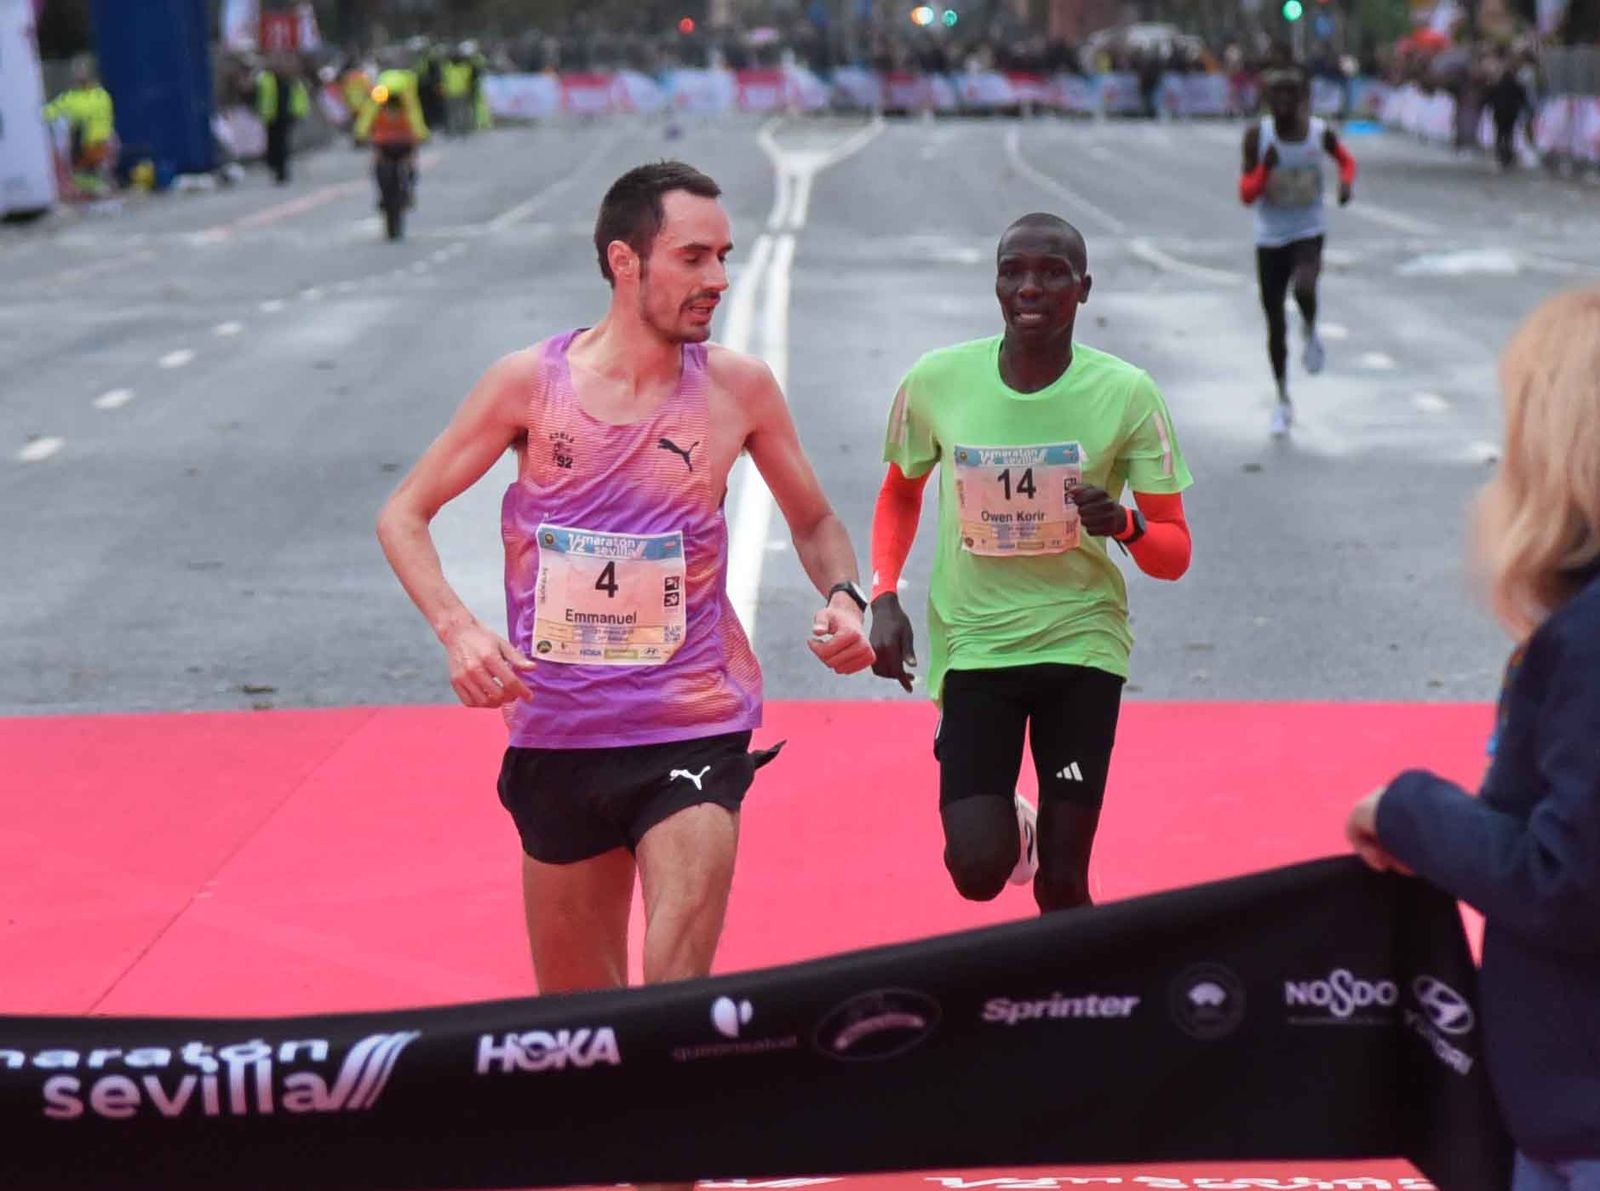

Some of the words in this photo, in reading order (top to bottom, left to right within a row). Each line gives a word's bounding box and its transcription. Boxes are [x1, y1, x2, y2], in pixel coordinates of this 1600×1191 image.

[997, 468, 1037, 501] 14
[981, 511, 1013, 522] Owen
[1017, 511, 1046, 522] Korir
[595, 561, 619, 598] 4
[565, 609, 637, 624] Emmanuel
[983, 991, 1140, 1025] Sprinter
[1284, 968, 1399, 1017] NOSDO
[476, 1027, 621, 1074] HOKA
[41, 1057, 336, 1119] sevilla
